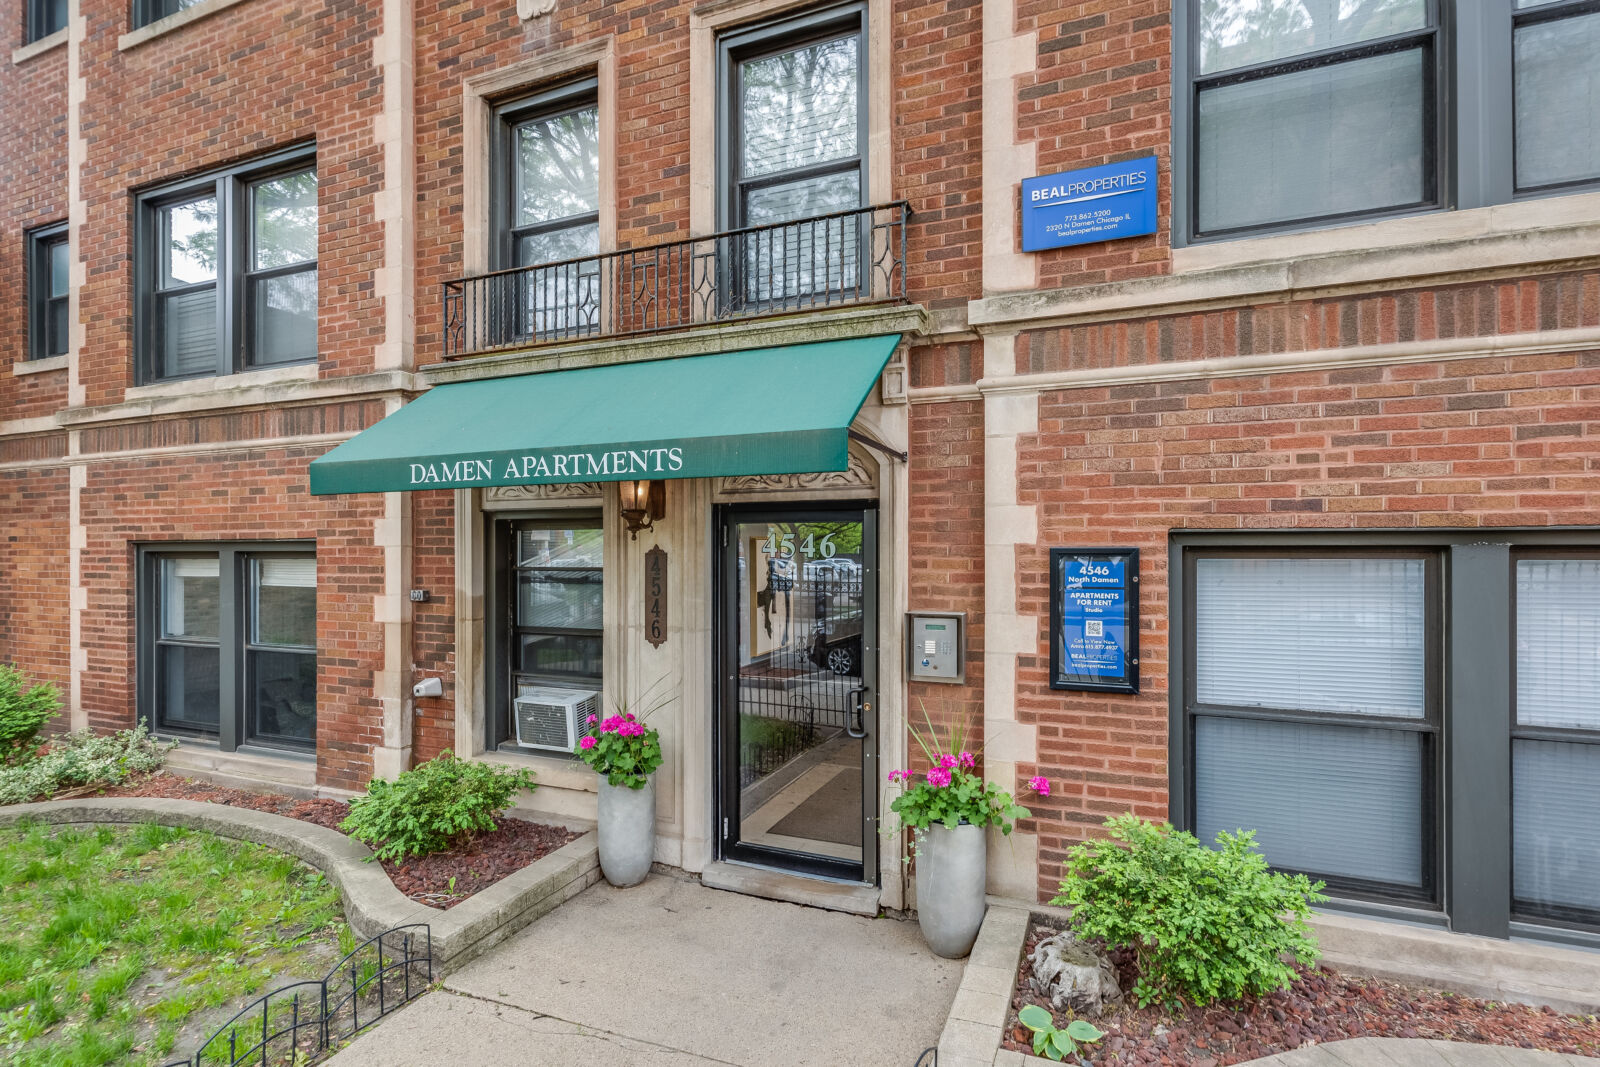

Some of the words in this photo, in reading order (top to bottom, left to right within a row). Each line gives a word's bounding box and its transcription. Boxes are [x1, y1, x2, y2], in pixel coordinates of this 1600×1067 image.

[1031, 171, 1147, 202] BEALPROPERTIES
[1045, 224, 1063, 233] 2320
[1071, 219, 1095, 228] Damen
[1096, 215, 1124, 226] Chicago
[1125, 212, 1132, 220] IL
[1064, 209, 1111, 222] 773.862.5200
[1057, 223, 1118, 238] bealproperties.com
[409, 459, 493, 484] DAMEN
[504, 447, 683, 479] APARTMENTS
[762, 532, 837, 559] 4546
[1079, 566, 1109, 575] 4546
[650, 555, 662, 639] 4546
[1070, 592, 1119, 600] APARTMENTS
